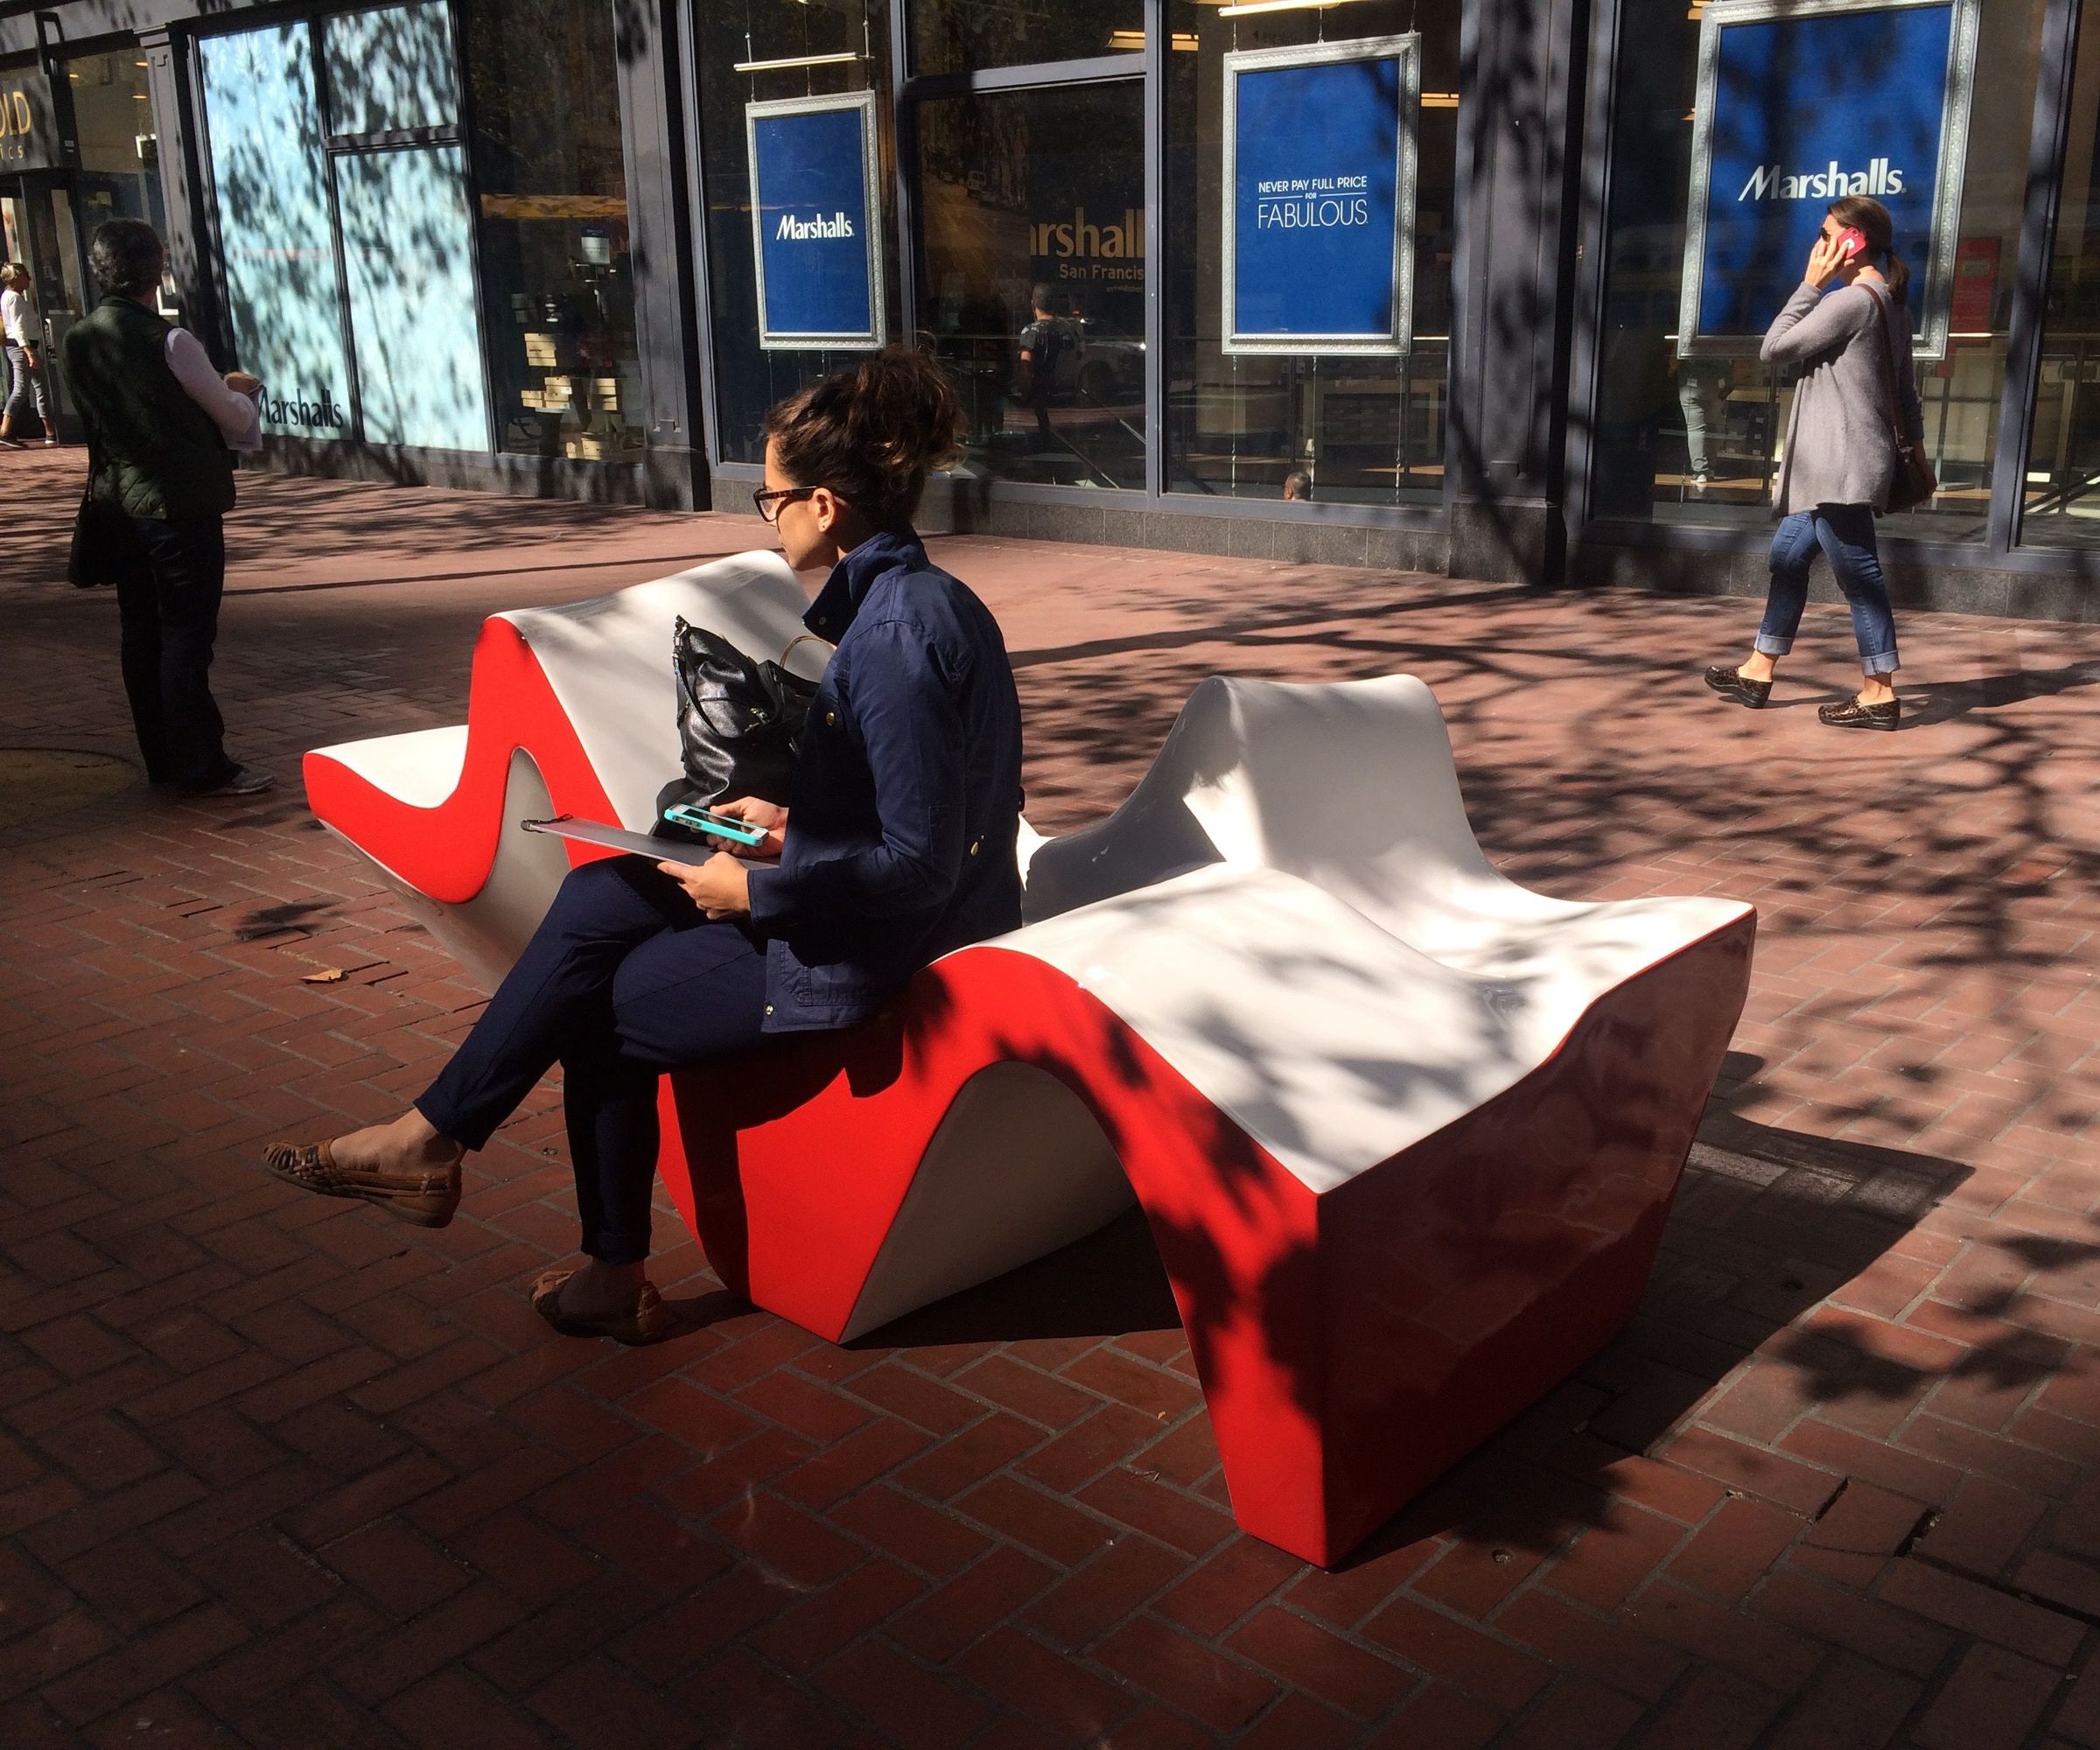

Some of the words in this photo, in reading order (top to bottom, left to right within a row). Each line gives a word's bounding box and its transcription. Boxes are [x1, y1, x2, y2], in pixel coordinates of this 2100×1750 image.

[1258, 181, 1289, 193] NEVER
[1292, 179, 1309, 191] PAY
[1312, 178, 1334, 190] FULL
[1337, 175, 1368, 189] PRICE
[1738, 158, 1904, 201] Marshalls
[776, 212, 854, 241] Marshalls
[1258, 199, 1368, 228] FABULOUS
[1060, 263, 1087, 280] San
